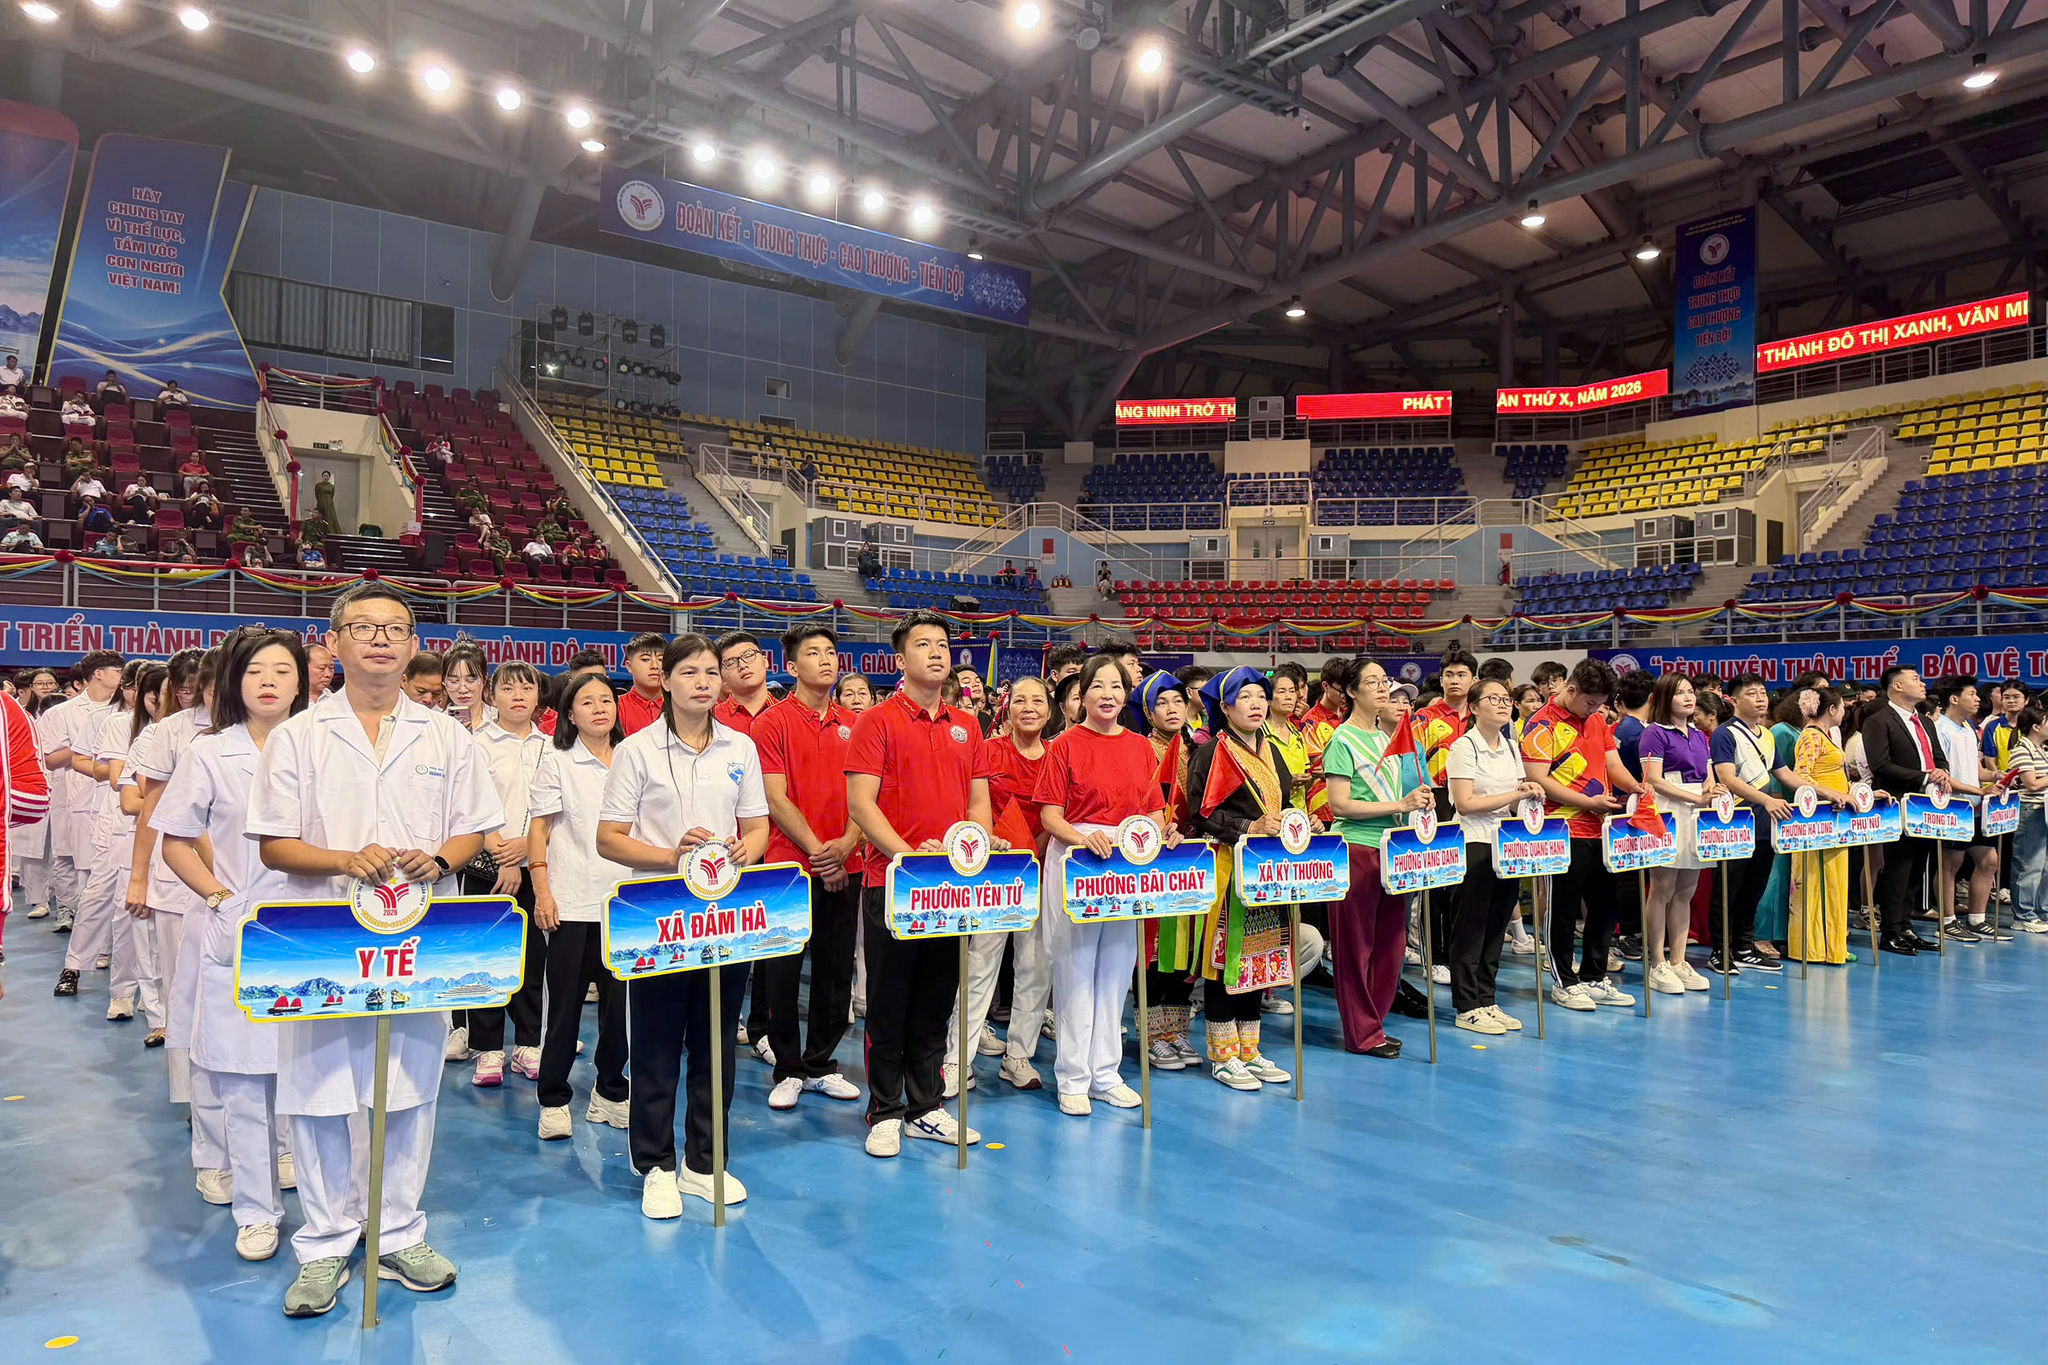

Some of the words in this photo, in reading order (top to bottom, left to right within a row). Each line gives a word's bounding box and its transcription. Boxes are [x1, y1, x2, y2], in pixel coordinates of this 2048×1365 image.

[108, 201, 158, 220] CHUNG
[161, 210, 184, 224] TAY
[676, 201, 714, 238] ĐOÀN
[717, 207, 742, 243] KẾT
[753, 221, 795, 257] TRUNG
[798, 232, 828, 268] THỰC
[839, 241, 862, 273] CAO
[864, 248, 909, 285] THƯỢNG
[919, 257, 944, 292] TIẾN
[106, 254, 137, 270] CON
[109, 272, 138, 289] VIỆT
[142, 278, 181, 295] NAM!
[1688, 291, 1716, 310] TRUNG
[1688, 314, 1704, 329] CAO
[1765, 340, 1823, 364] THÀNH
[1827, 333, 1855, 353] ĐÔ
[1860, 326, 1889, 346] THỊ
[1893, 316, 1952, 340] XANH,
[1957, 305, 1999, 327] VĂN
[1403, 394, 1444, 410] PHÁT
[1522, 391, 1556, 406] THỨ
[1559, 393, 1574, 407] X,
[1578, 387, 1607, 404] NĂM
[1610, 381, 1642, 398] 2026
[1147, 405, 1181, 418] NINH
[16, 613, 103, 651] TRIỂN
[110, 622, 203, 654] THÀNH
[551, 637, 580, 666] ĐÔ
[861, 650, 898, 674] GIÀU
[1782, 653, 1846, 681] THÂN
[1922, 645, 1977, 678] BẢO
[1700, 828, 1724, 845] PHƯỜNG
[1781, 822, 1807, 838] PHƯỜNG
[1817, 822, 1833, 834] LONG
[1851, 819, 1868, 833] PHỤ
[1503, 839, 1528, 859] PHƯỜNG
[1549, 840, 1566, 856] HANH
[1614, 835, 1638, 854] PHƯỜNG
[1258, 860, 1274, 883] XÃ
[1276, 859, 1290, 881] KỲ
[1292, 860, 1333, 884] THƯỢNG
[1394, 849, 1422, 873] PHƯỜNG
[1422, 847, 1440, 869] VÀNG
[1441, 847, 1459, 866] DANH
[910, 883, 971, 911] PHƯỜNG
[975, 881, 1002, 907] YÊN
[1005, 877, 1024, 906] TỬ
[1075, 872, 1136, 898] PHƯỜNG
[1140, 870, 1164, 893] BÃI
[1169, 868, 1207, 891] CHÁY
[657, 911, 686, 944] XÃ
[690, 904, 736, 939] ĐẦM
[741, 901, 767, 932] HÀ
[357, 948, 377, 979] Y
[382, 936, 420, 978] TẾ
